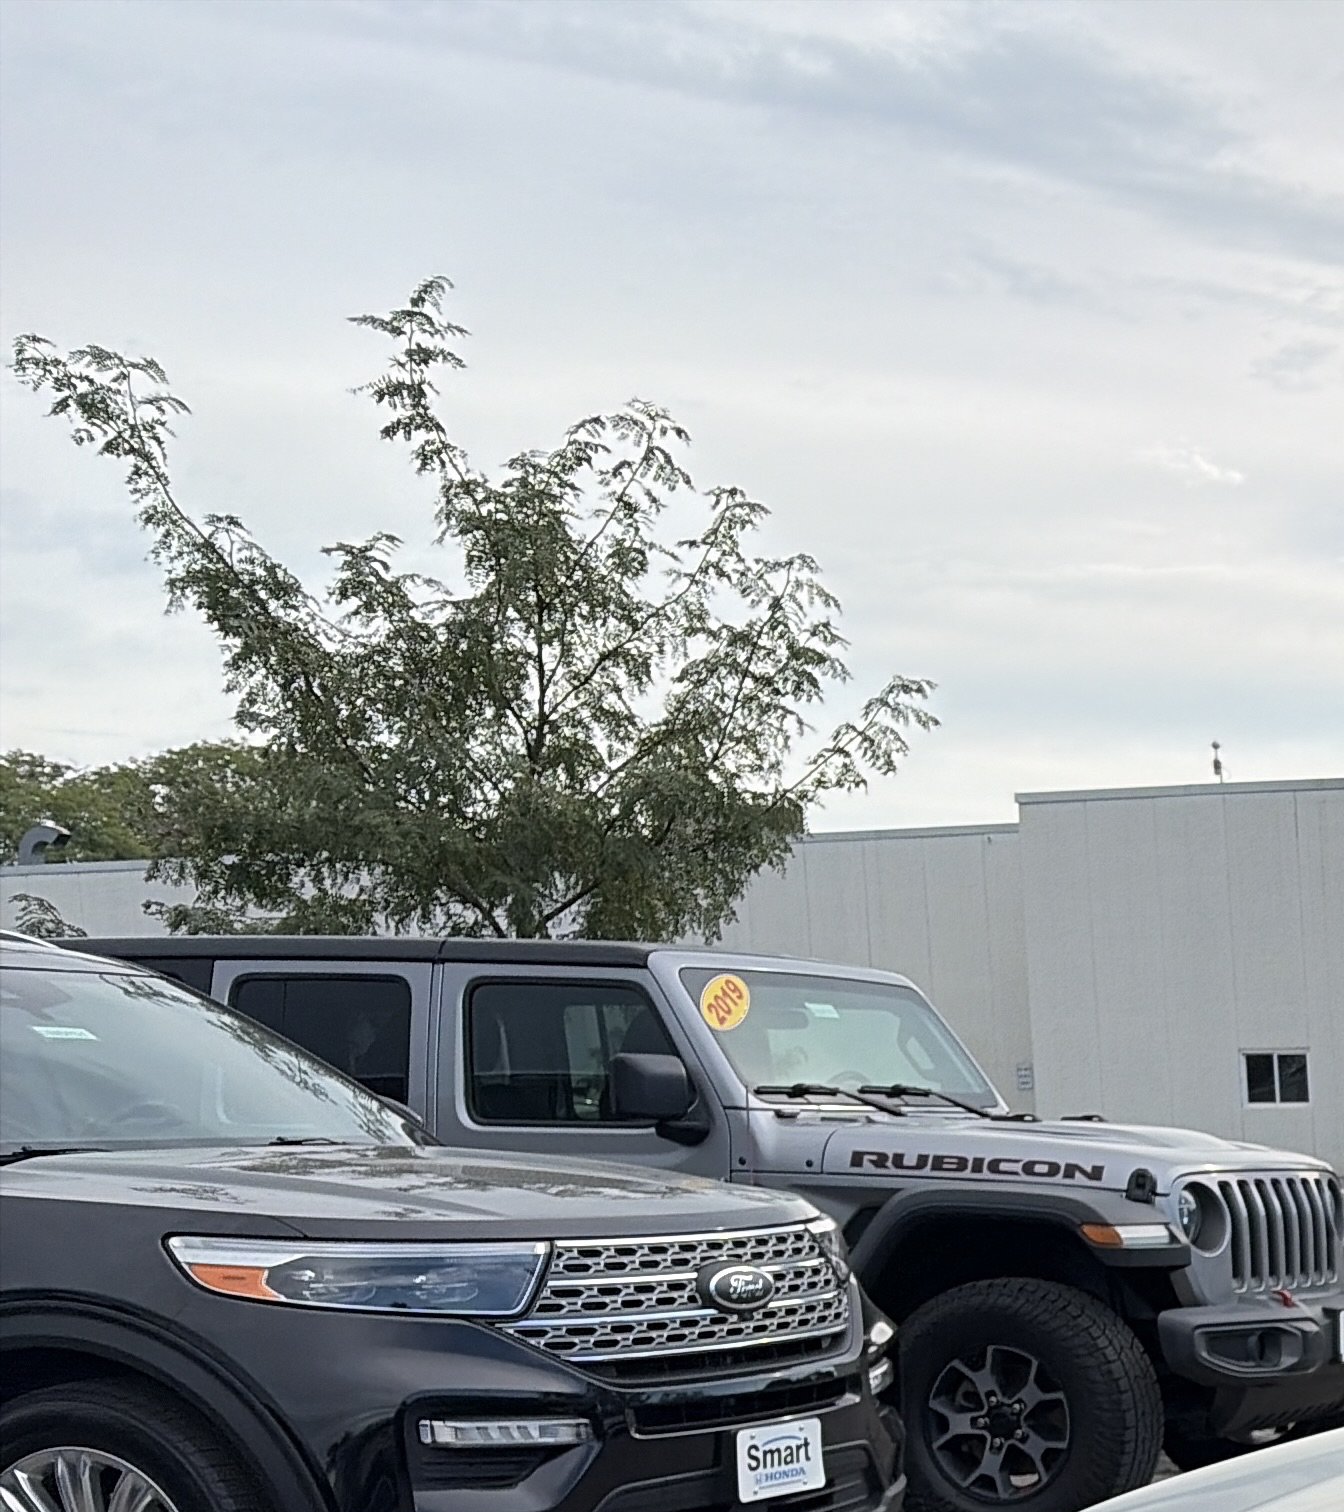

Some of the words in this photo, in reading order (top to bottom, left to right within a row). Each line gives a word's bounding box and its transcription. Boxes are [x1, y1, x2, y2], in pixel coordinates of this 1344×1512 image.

[707, 979, 743, 1025] 2019
[850, 1150, 1105, 1182] RUBICON
[729, 1274, 763, 1296] Ford
[747, 1437, 811, 1471] Smart
[764, 1467, 807, 1482] HONDA
